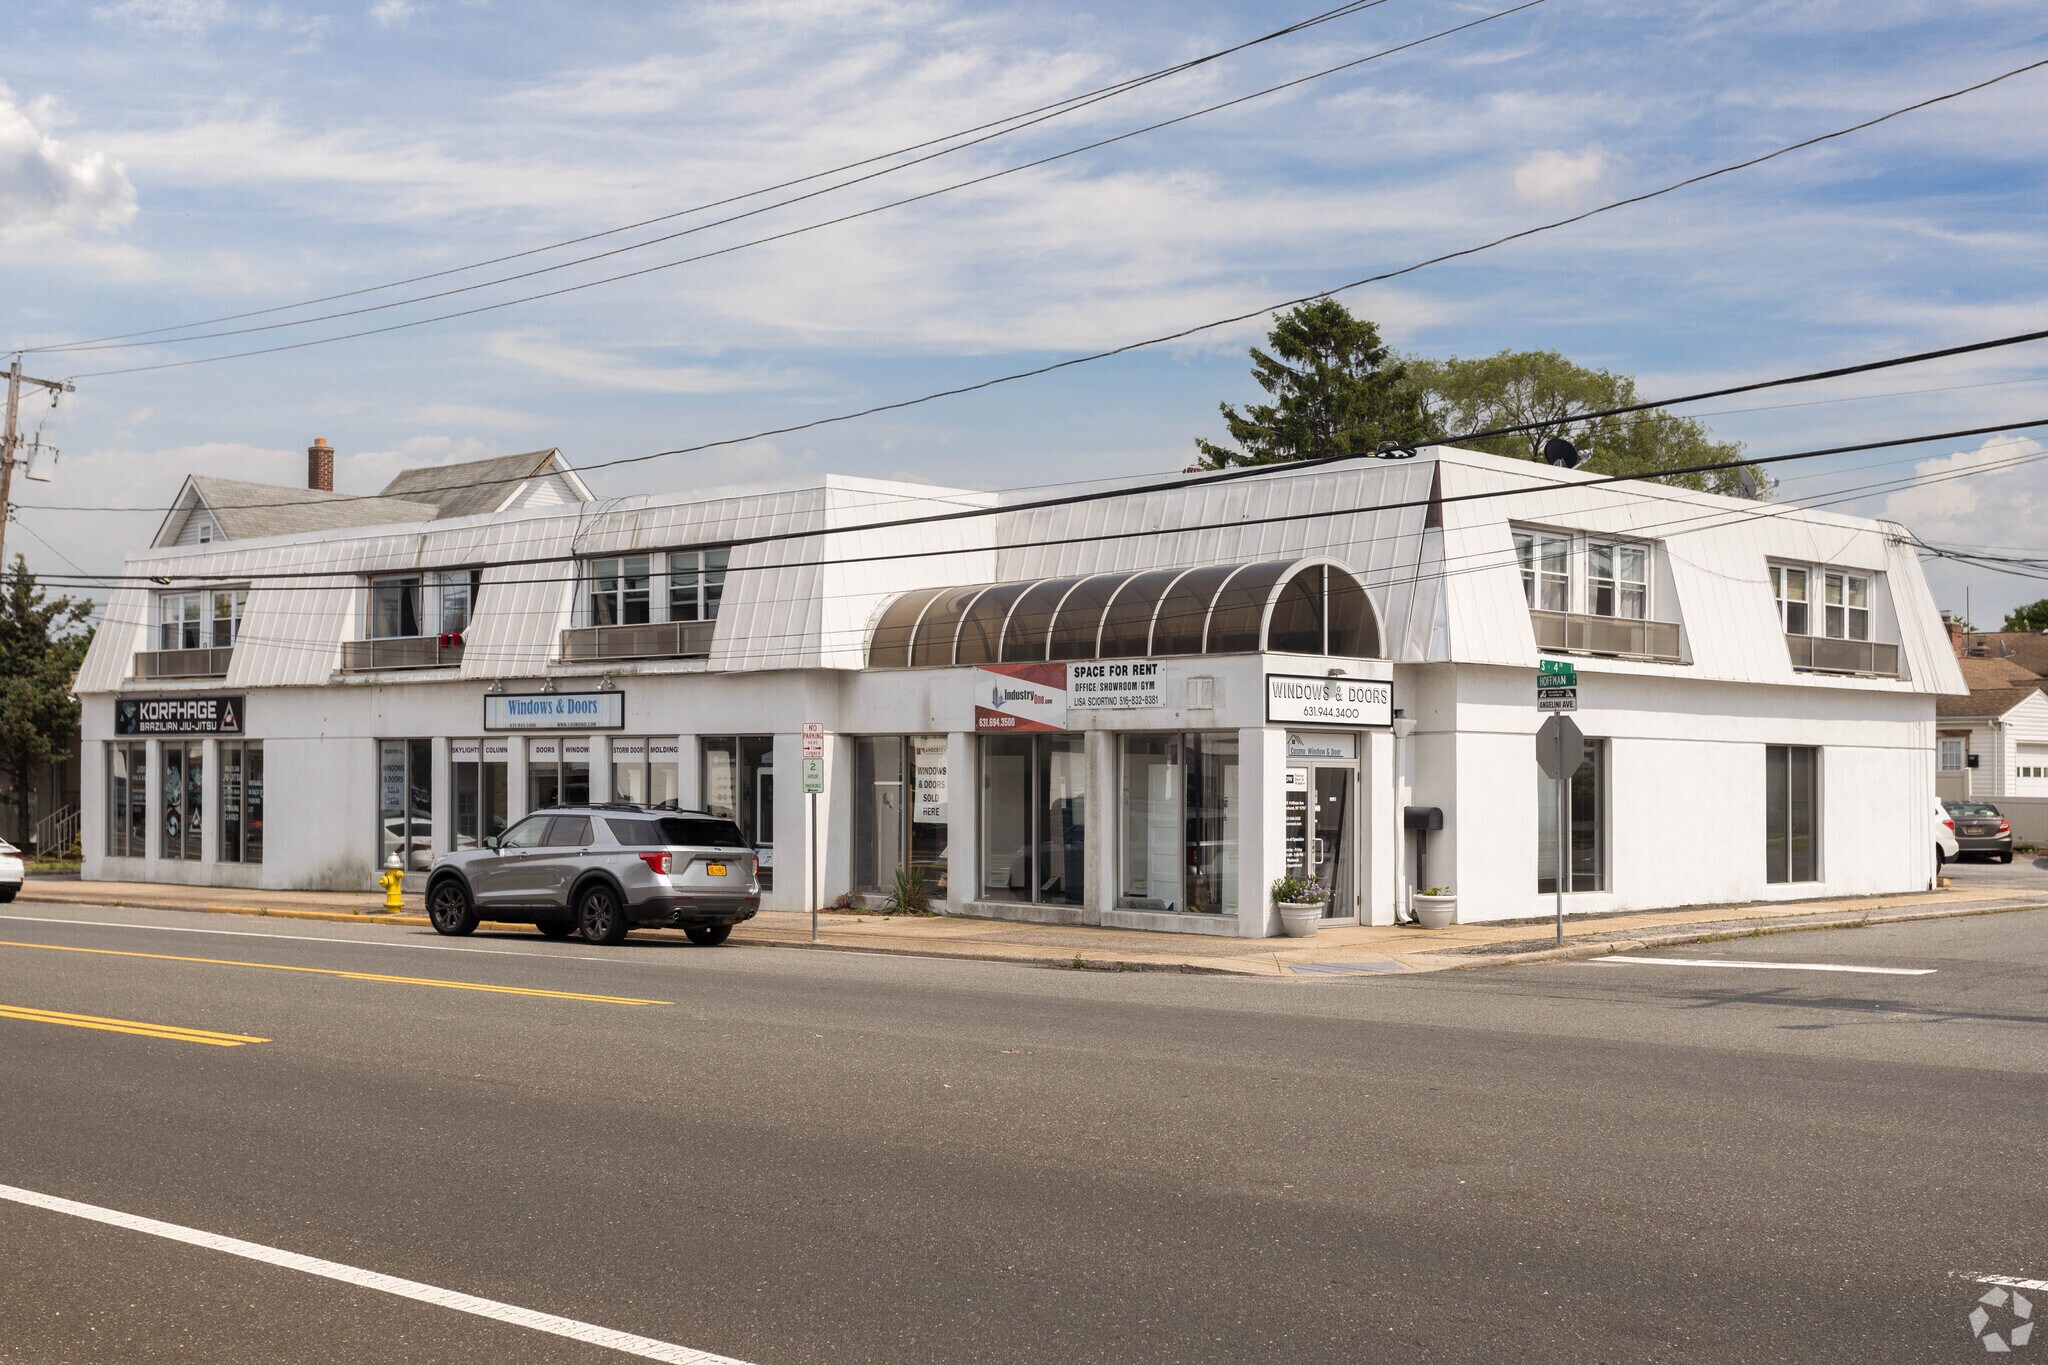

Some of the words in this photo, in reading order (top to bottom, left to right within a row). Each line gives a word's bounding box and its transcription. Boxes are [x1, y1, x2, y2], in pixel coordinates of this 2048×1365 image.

[1074, 665, 1105, 678] SPACE
[1109, 664, 1128, 677] FOR
[1132, 663, 1158, 676] RENT
[1541, 660, 1546, 671] S
[1540, 675, 1566, 687] HOFFMAN
[1272, 681, 1330, 701] WINDOWS
[1335, 686, 1343, 702] &
[1348, 686, 1388, 705] DOORS
[1074, 697, 1086, 706] LISA
[1088, 696, 1118, 706] SCIORTINO
[1119, 695, 1159, 705] 516-832-8381
[1540, 701, 1562, 709] ANGELINI
[140, 701, 217, 720] KORFHAGE
[508, 699, 553, 715] Windows
[556, 698, 564, 714] &
[567, 698, 598, 714] Doors
[1303, 706, 1360, 719] 631.944.3400
[140, 722, 178, 732] BRAZILIAN
[180, 721, 217, 731] JIU-JITSU
[979, 717, 1016, 728] 631.694.3500
[1307, 747, 1325, 755] Window
[1331, 748, 1341, 756] Door
[810, 763, 816, 771] 2
[917, 767, 947, 775] WINDOWS
[918, 780, 923, 789] &
[924, 780, 946, 789] DOORS
[923, 794, 939, 802] SOLD
[923, 807, 940, 816] HERE
